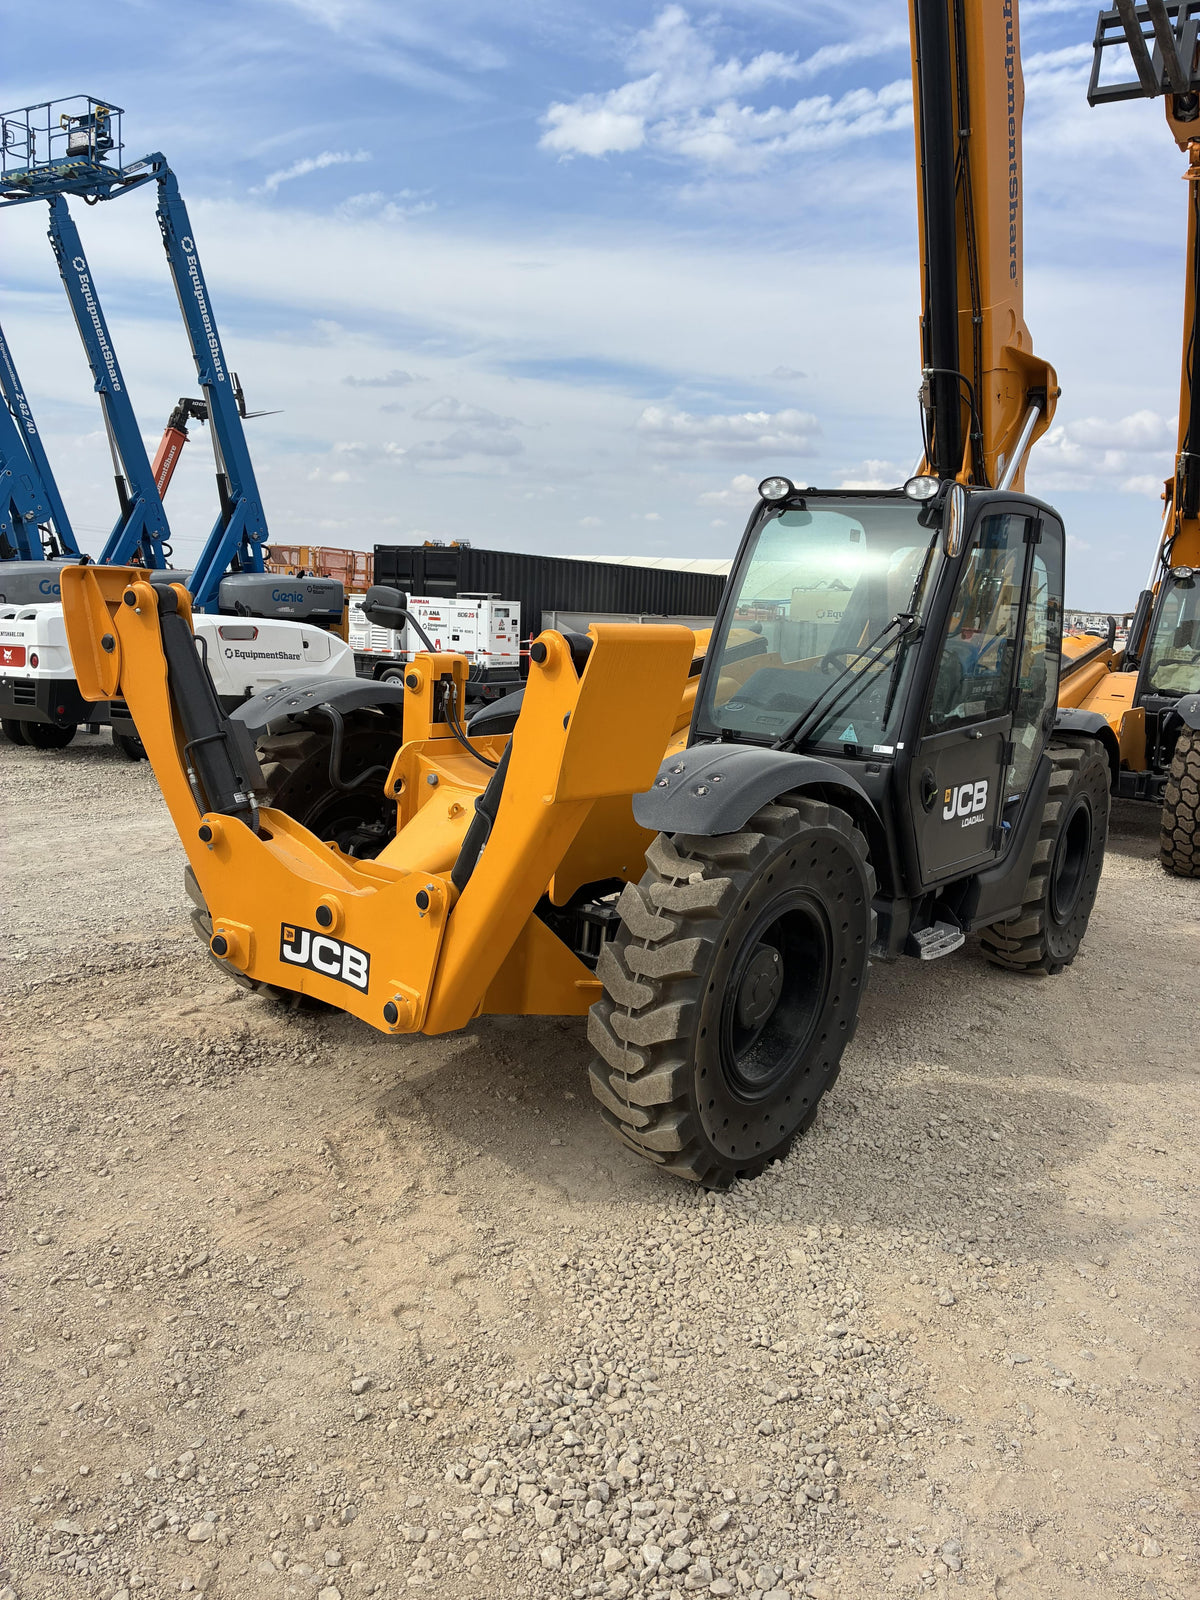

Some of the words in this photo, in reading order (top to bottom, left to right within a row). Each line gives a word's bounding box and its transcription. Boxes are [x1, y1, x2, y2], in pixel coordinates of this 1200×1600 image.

[1002, 0, 1018, 281] quipmentShare
[78, 273, 121, 392] EquipmentShare
[187, 254, 225, 382] EquipmentShare
[16, 393, 36, 434] Z-62/40
[157, 445, 177, 494] pmentShare
[39, 580, 61, 595] Ge
[272, 589, 304, 603] Genie
[827, 609, 845, 619] Equ
[234, 649, 301, 660] EquipmentShare
[943, 780, 988, 820] JCB
[961, 813, 985, 828] LOADALL
[283, 930, 368, 988] JCB
